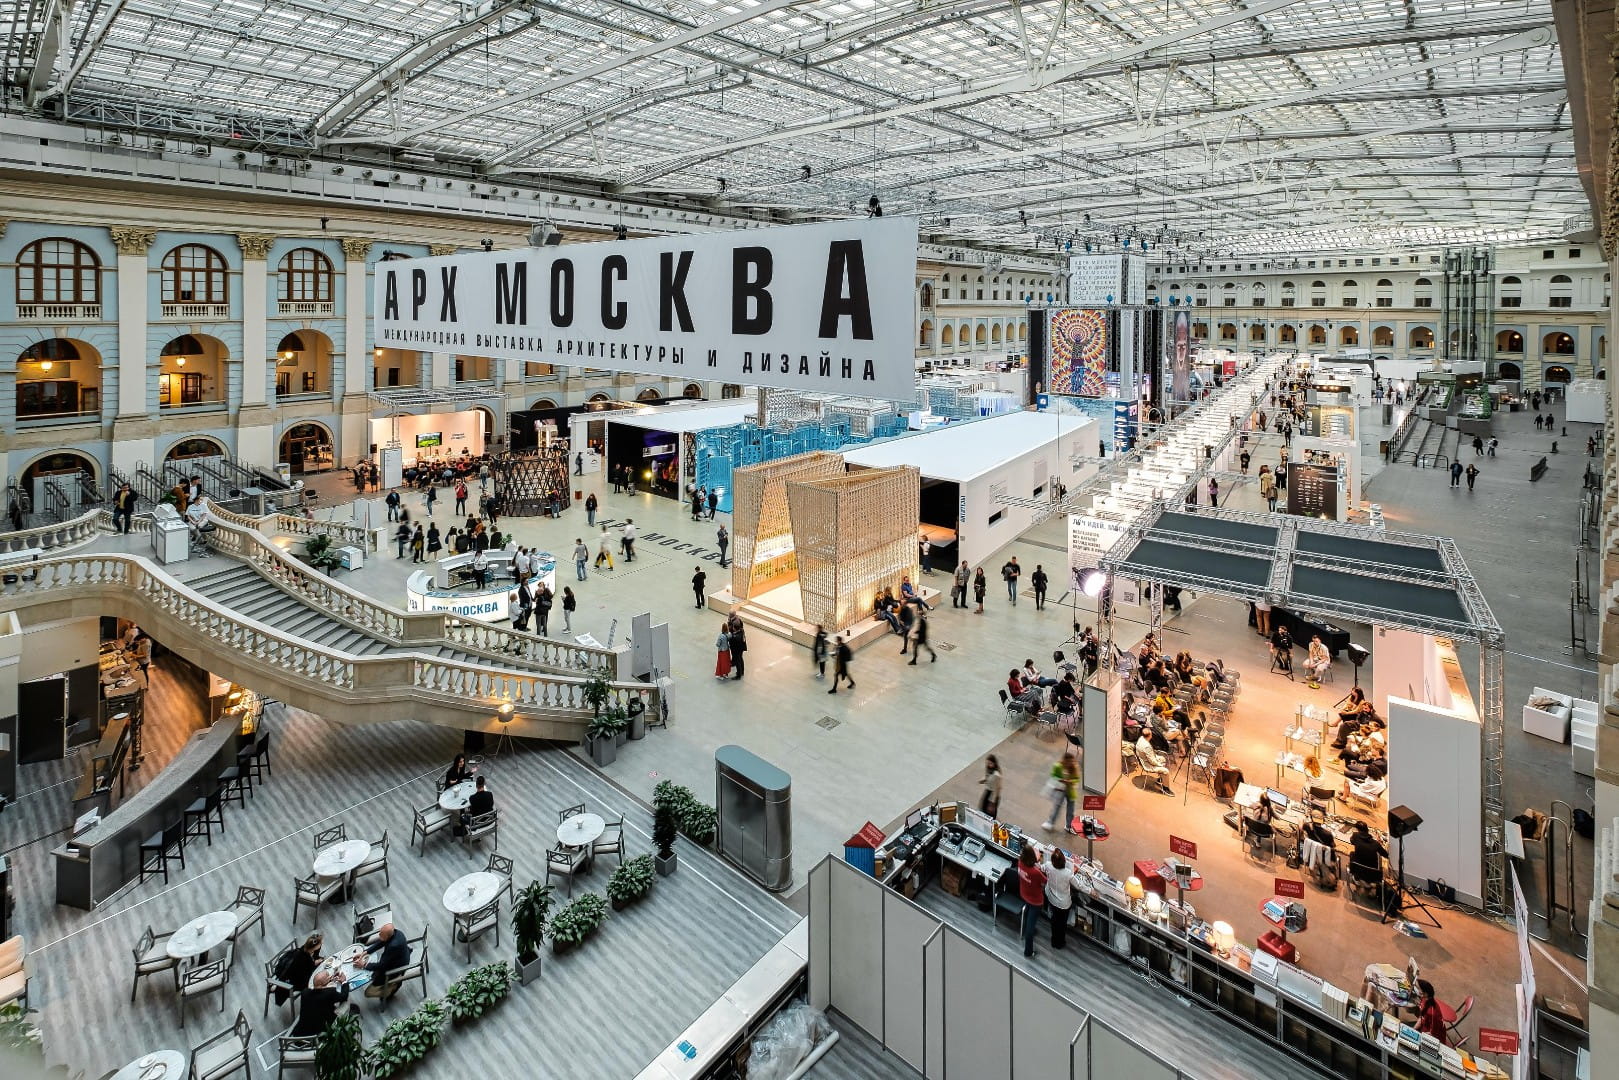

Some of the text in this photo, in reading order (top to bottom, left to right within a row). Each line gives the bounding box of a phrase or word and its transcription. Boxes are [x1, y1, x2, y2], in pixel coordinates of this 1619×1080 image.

[384, 239, 874, 341] АРХ МОСКВА
[384, 328, 875, 381] МЕЖДУНАРОДНАЯ ВЫСТАВКА АРХИТЕКТУРЫ И ДИЗАЙНА
[596, 519, 641, 529] АР
[452, 602, 498, 616] МОСКВА
